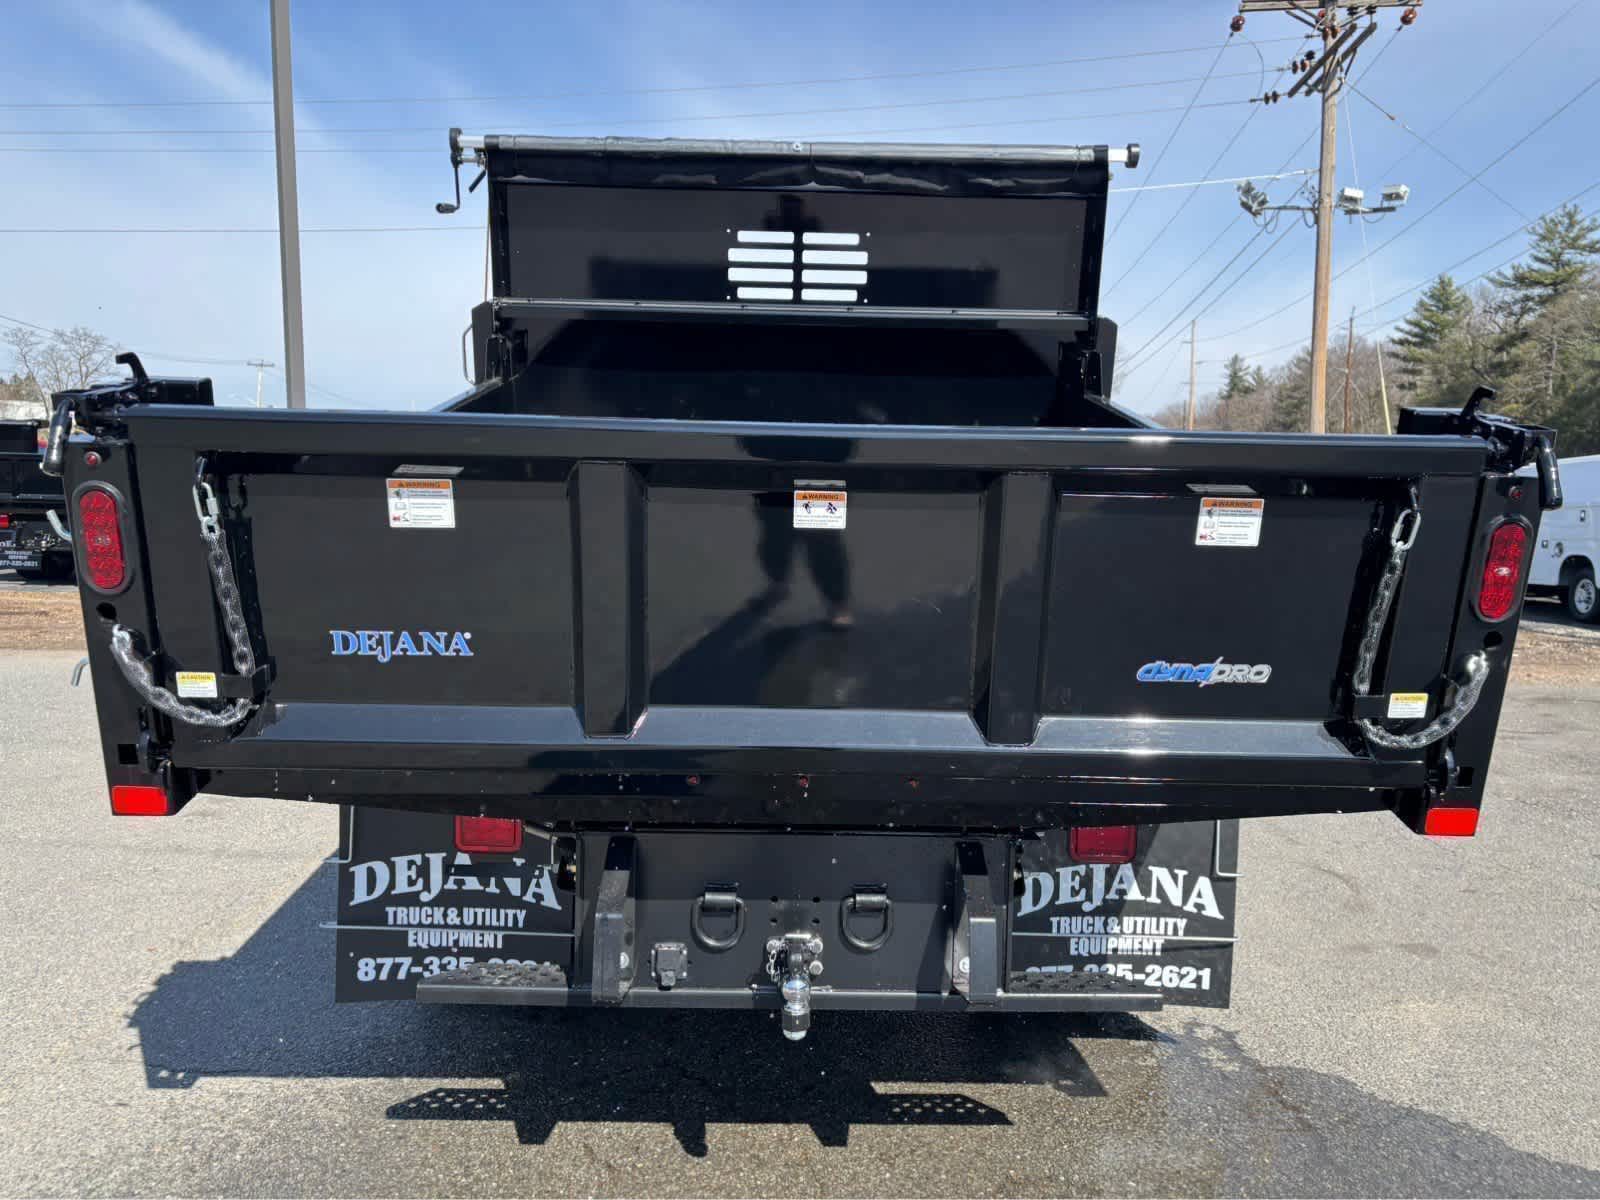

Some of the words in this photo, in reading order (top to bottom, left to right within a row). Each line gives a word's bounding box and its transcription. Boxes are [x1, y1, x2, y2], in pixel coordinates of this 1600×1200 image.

[329, 630, 474, 663] DEJANA
[349, 852, 562, 911] DEJANA
[1016, 863, 1224, 920] DEJANA
[407, 929, 505, 949] EQUIPMENT
[1069, 936, 1165, 956] EQUIPMENT
